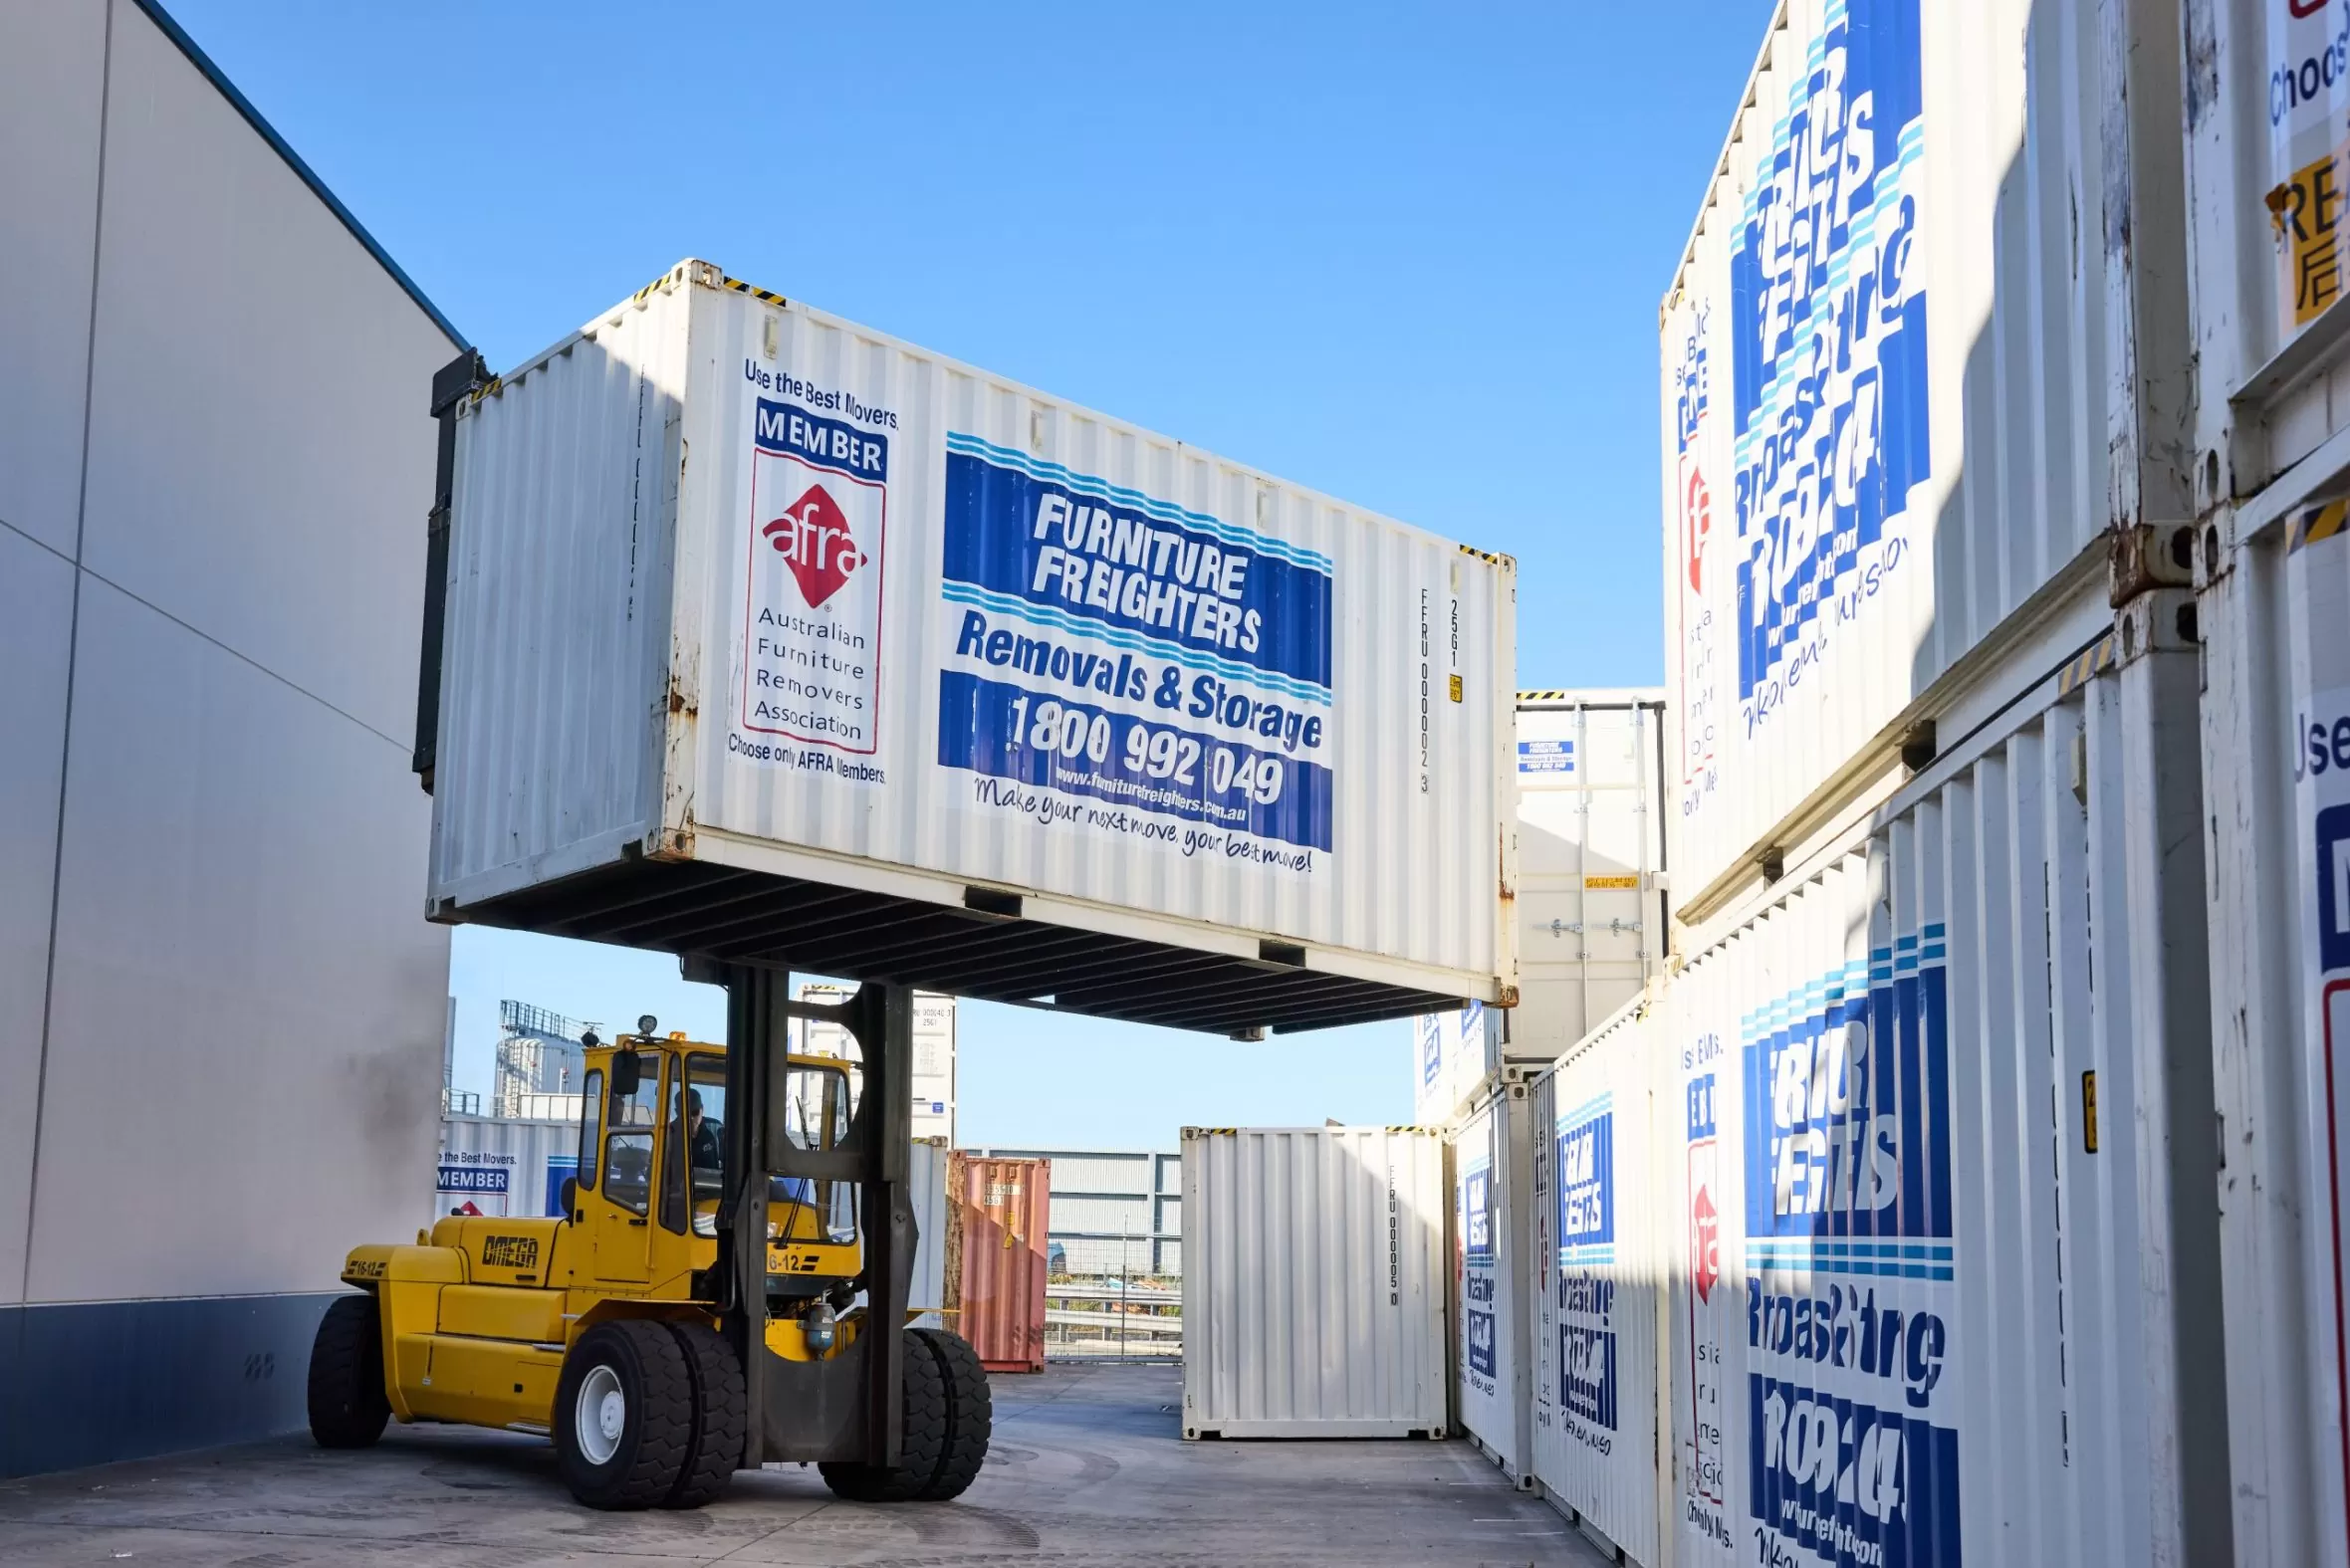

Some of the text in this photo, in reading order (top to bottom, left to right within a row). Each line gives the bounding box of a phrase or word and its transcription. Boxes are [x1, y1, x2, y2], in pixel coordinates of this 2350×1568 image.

[745, 358, 899, 431] Use the Best Movers.
[758, 406, 882, 472] MEMBER
[767, 503, 863, 578] afra
[1033, 493, 1250, 599] FURNITURE
[758, 607, 864, 649] Australian
[1032, 546, 1263, 654] FREIGHTERS
[758, 637, 864, 679] Furniture
[956, 610, 1323, 752] Removals & Storage
[757, 669, 863, 710] Removers
[755, 701, 861, 740] Association
[728, 733, 886, 784] Choose only AFRA Members.
[1014, 696, 1284, 805] 1800 992 049
[974, 778, 1037, 813] Make
[1038, 794, 1082, 825] your
[1087, 808, 1128, 832] next
[1130, 818, 1179, 843] move,
[1185, 828, 1223, 857] your
[1263, 850, 1313, 872] move!
[438, 1170, 506, 1188] MEMBER
[445, 1152, 458, 1163] the
[461, 1152, 481, 1164] Best
[483, 1153, 517, 1165] Movers.
[482, 1234, 539, 1268] OMEGA
